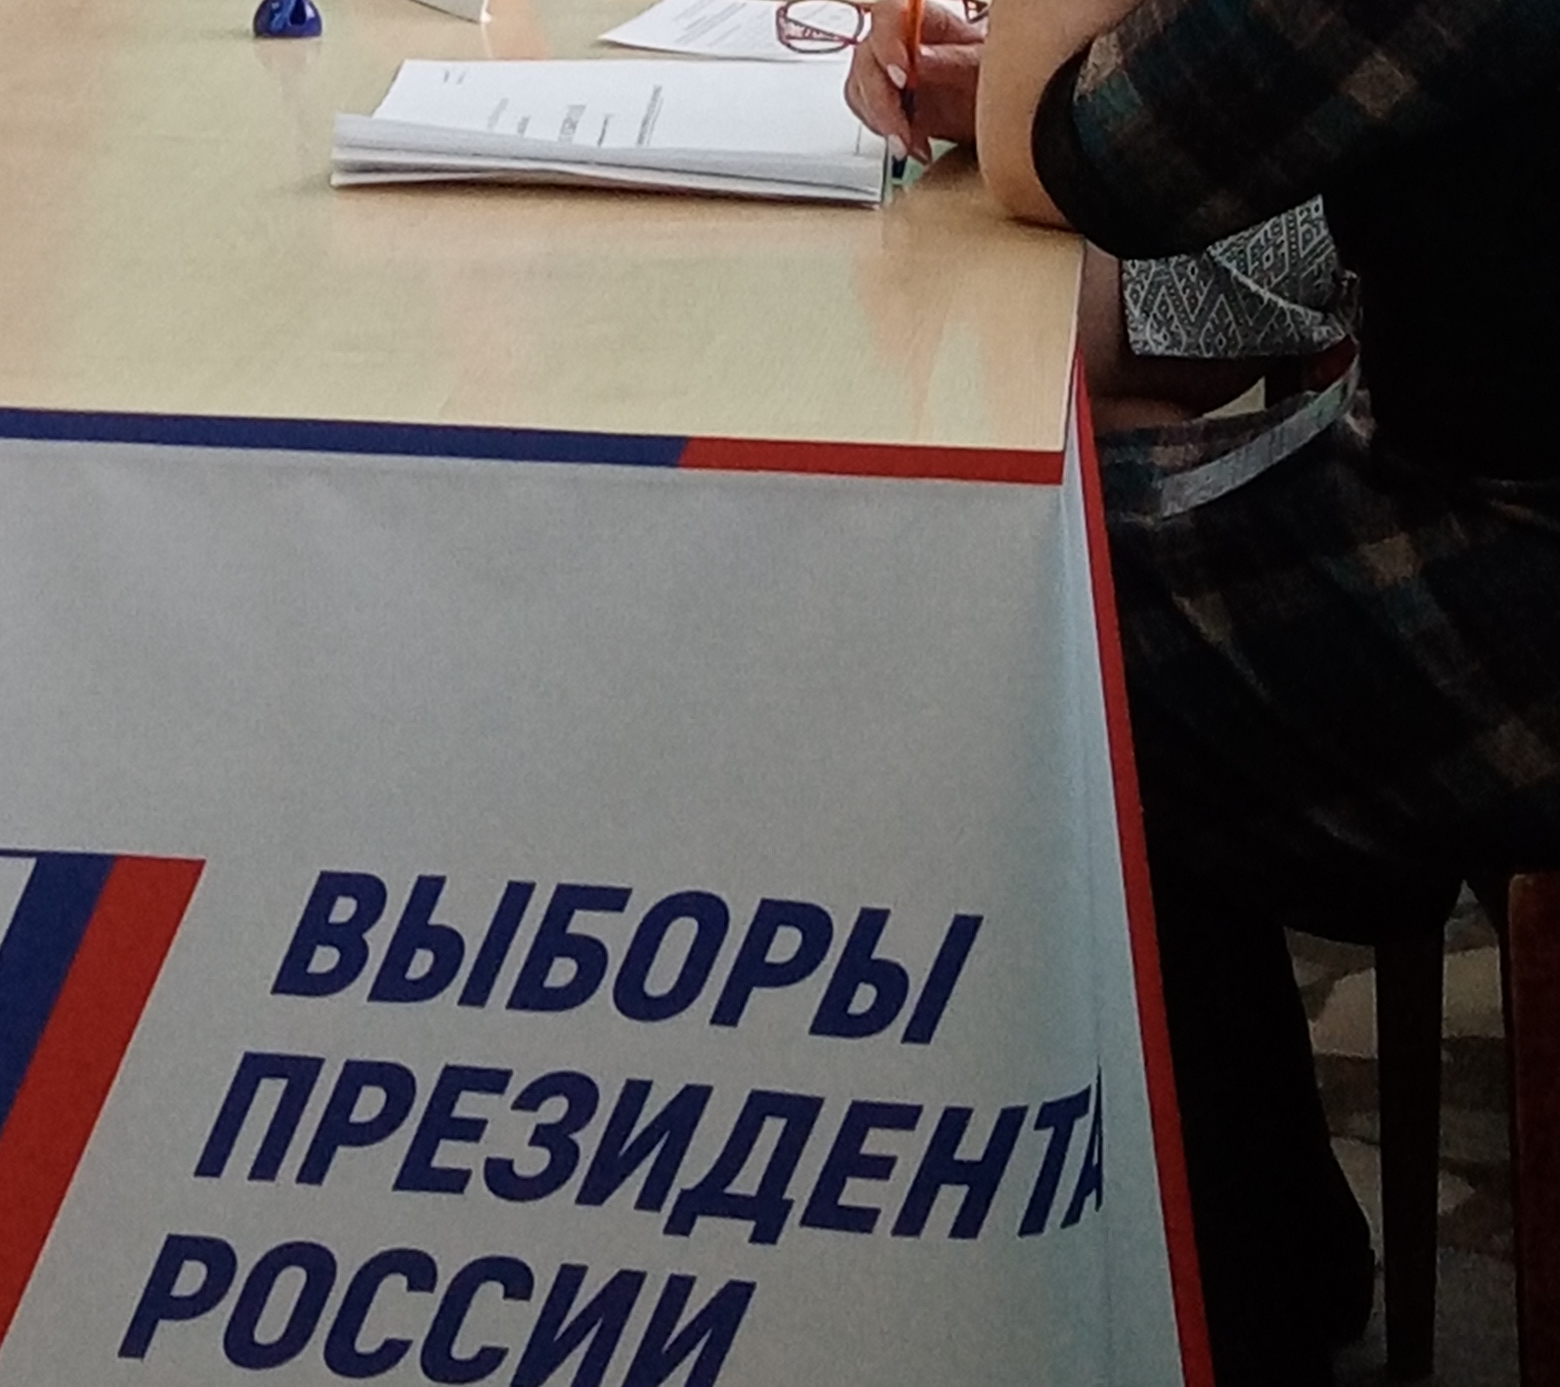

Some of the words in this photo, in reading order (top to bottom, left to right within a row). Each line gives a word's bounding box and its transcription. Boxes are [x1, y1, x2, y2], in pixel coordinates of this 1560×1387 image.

[270, 869, 984, 1045] ВЫБОРЫ
[193, 1051, 1104, 1245] ПРЕЗИДЕНТА
[117, 1232, 758, 1387] РОССИИ
